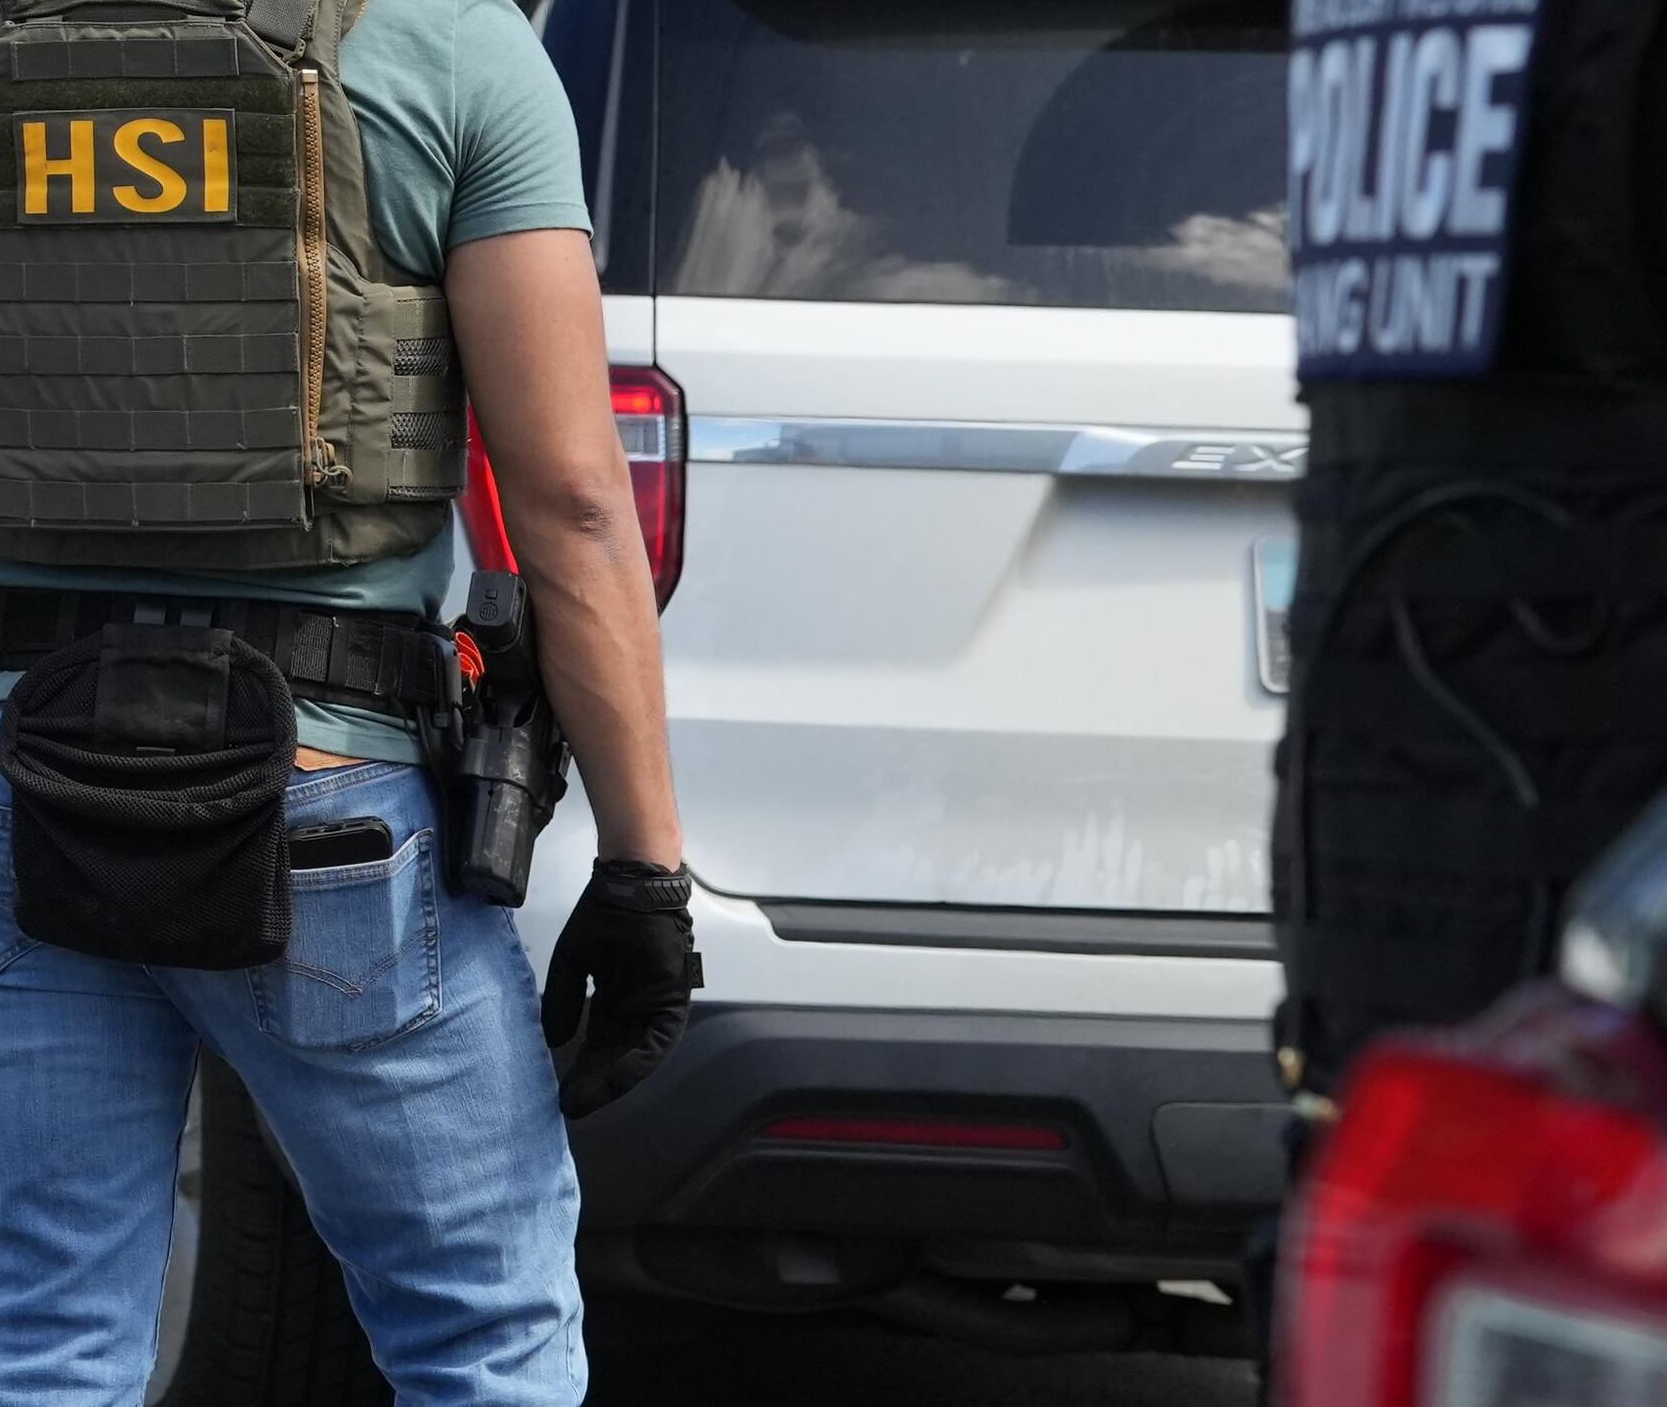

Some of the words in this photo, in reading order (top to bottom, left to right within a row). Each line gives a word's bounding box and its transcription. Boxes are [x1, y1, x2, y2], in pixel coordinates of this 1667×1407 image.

[20, 117, 230, 216] HSI
[1288, 23, 1534, 249] POLICE
[1369, 251, 1502, 355] UNIT
